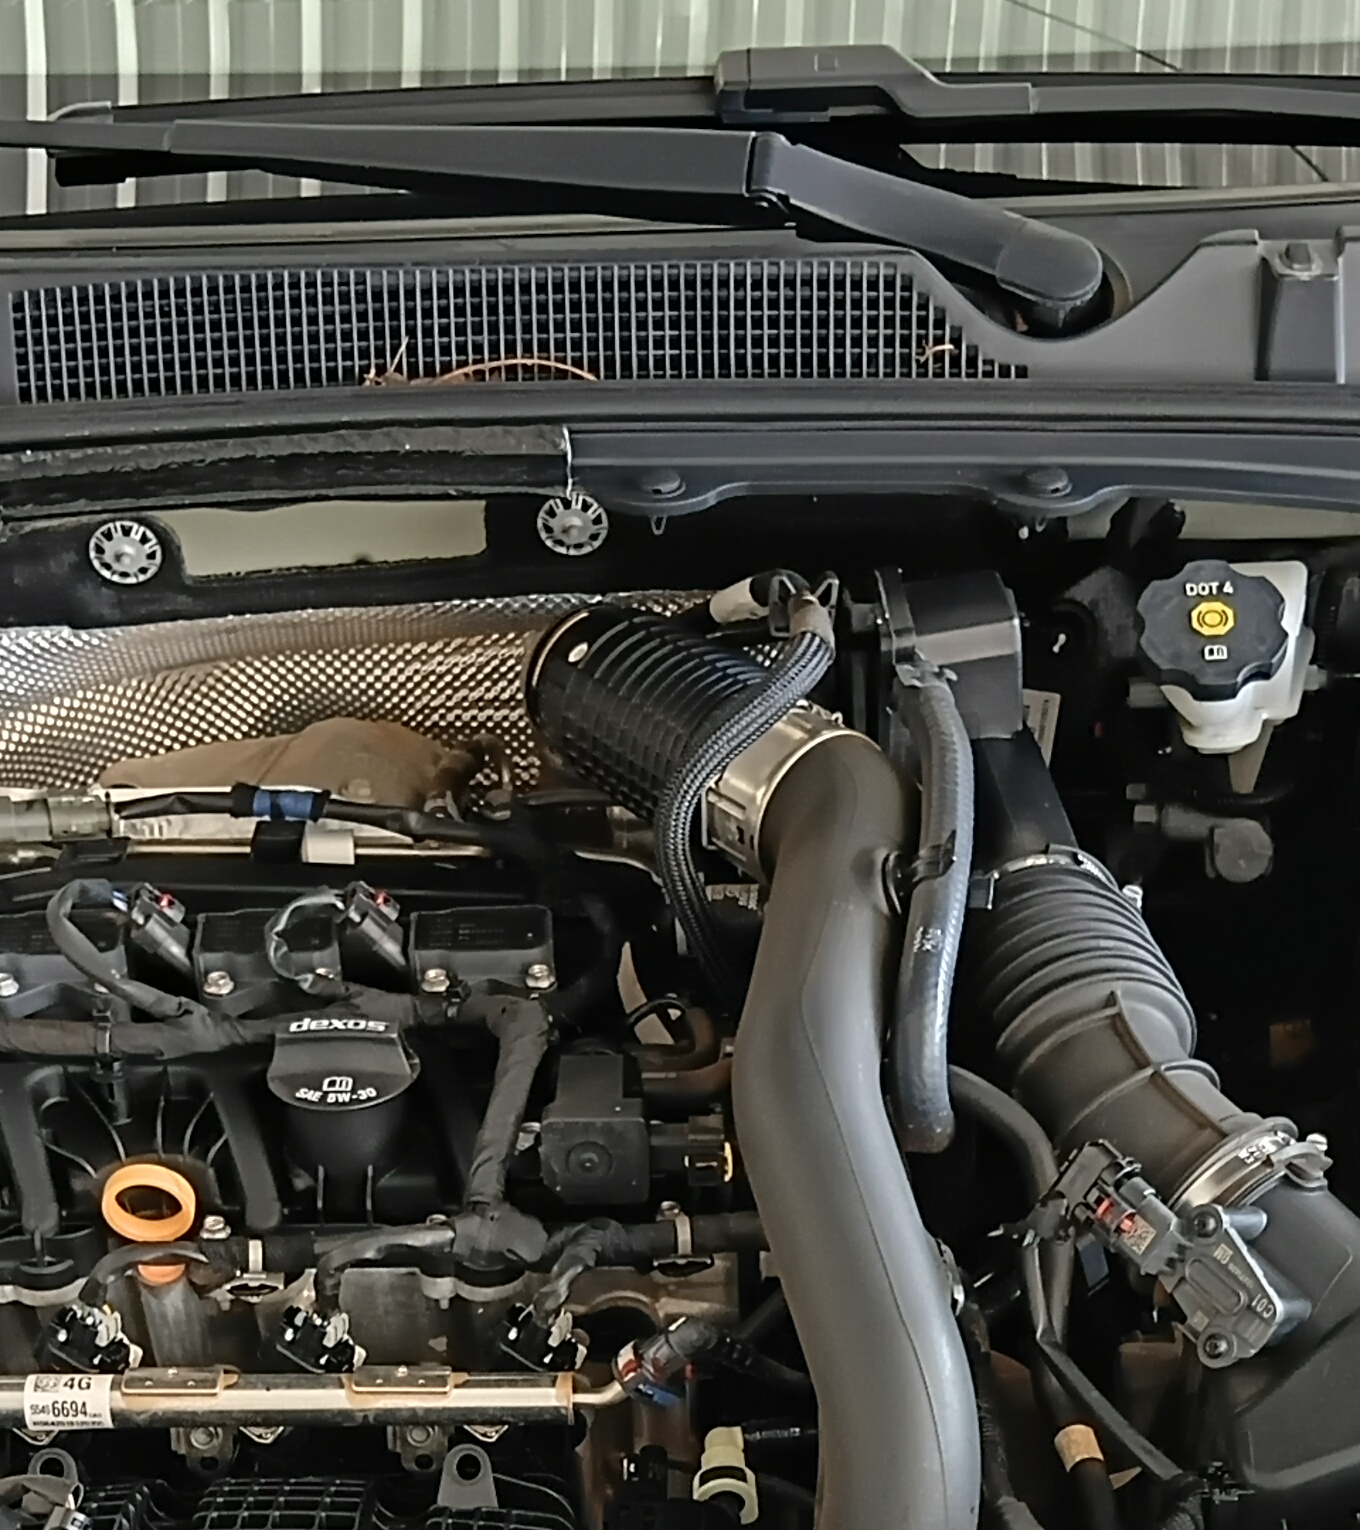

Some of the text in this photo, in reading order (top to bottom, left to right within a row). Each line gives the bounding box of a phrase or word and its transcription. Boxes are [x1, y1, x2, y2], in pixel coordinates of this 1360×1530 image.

[1186, 581, 1234, 596] DOT 4
[290, 1018, 389, 1032] dexos
[296, 1088, 377, 1103] SAE 5W-30
[1251, 1293, 1275, 1318] C01
[63, 1376, 91, 1390] 4G
[51, 1401, 88, 1417] 6694
